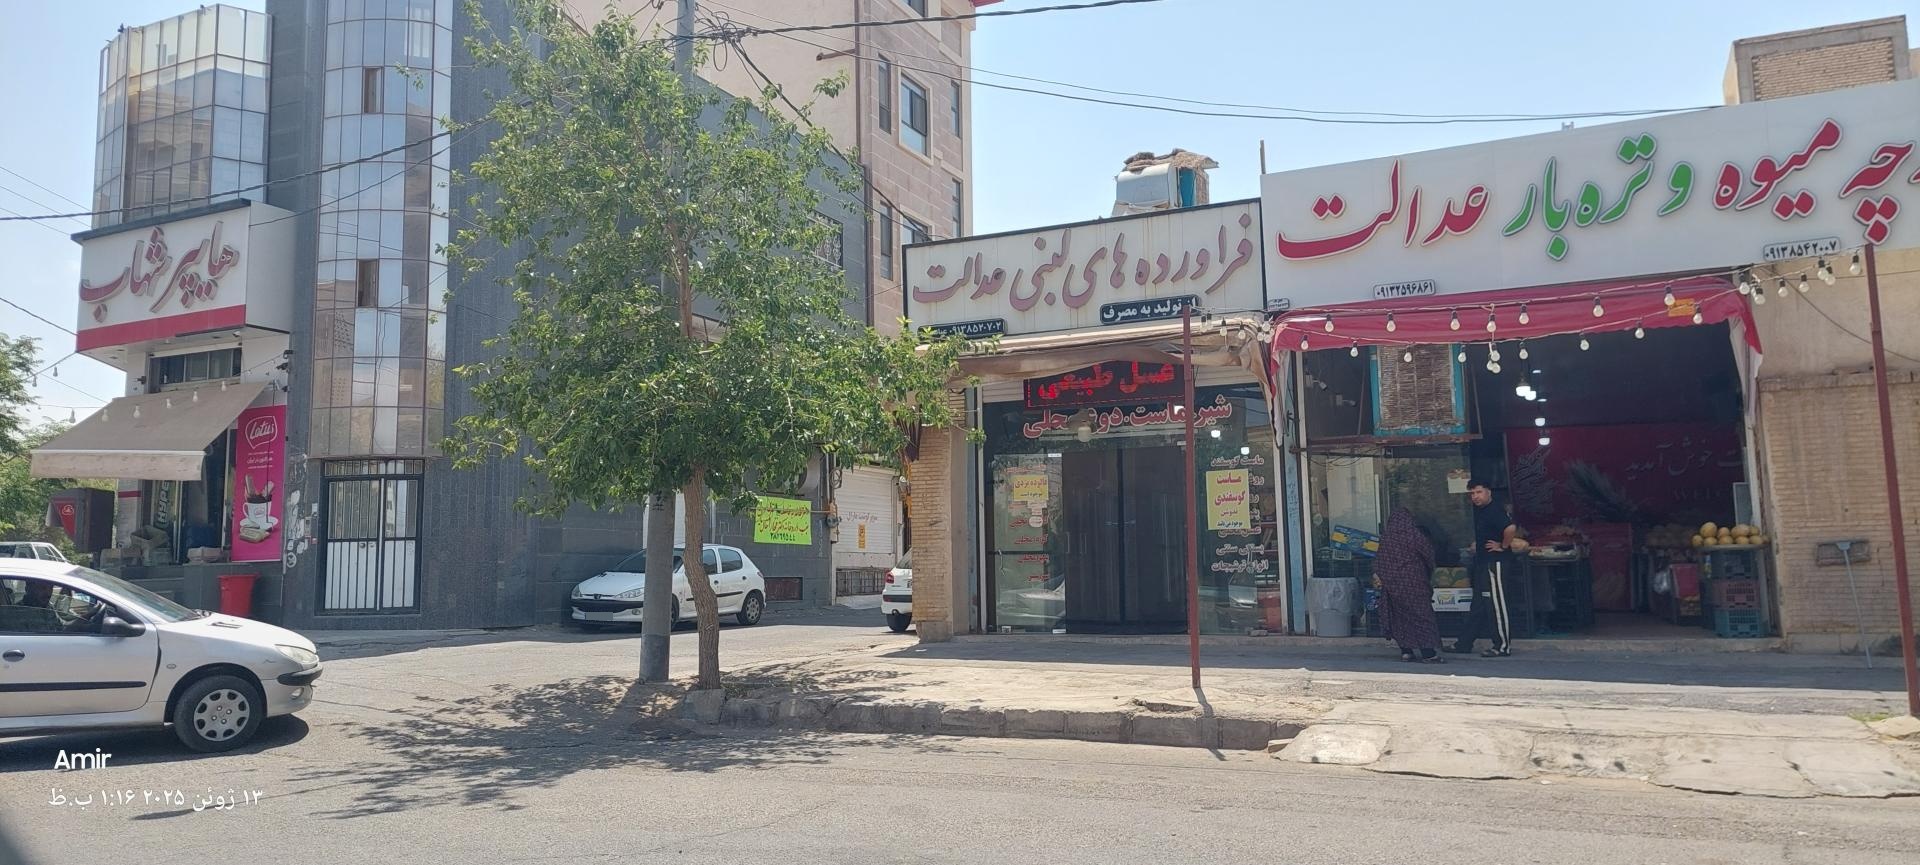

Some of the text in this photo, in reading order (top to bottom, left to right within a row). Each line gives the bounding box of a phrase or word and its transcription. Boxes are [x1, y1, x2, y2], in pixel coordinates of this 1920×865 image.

[1712, 117, 1843, 221] میوه
[1276, 156, 1491, 262] عدالت
[78, 220, 240, 323] هایپر شهاب
[912, 212, 1253, 313] فراورده های لبنی عدالت
[1376, 281, 1434, 297] ۰۹۱۳۲۵۹۶۸۶۱
[1103, 306, 1137, 321] مصرف
[1140, 304, 1151, 318] به
[1154, 299, 1182, 316] تولید
[1037, 360, 1176, 399] عسل طبیعی
[1023, 409, 1072, 439] حلی
[1216, 472, 1242, 485] ماست
[1214, 490, 1246, 506] گوسفندی
